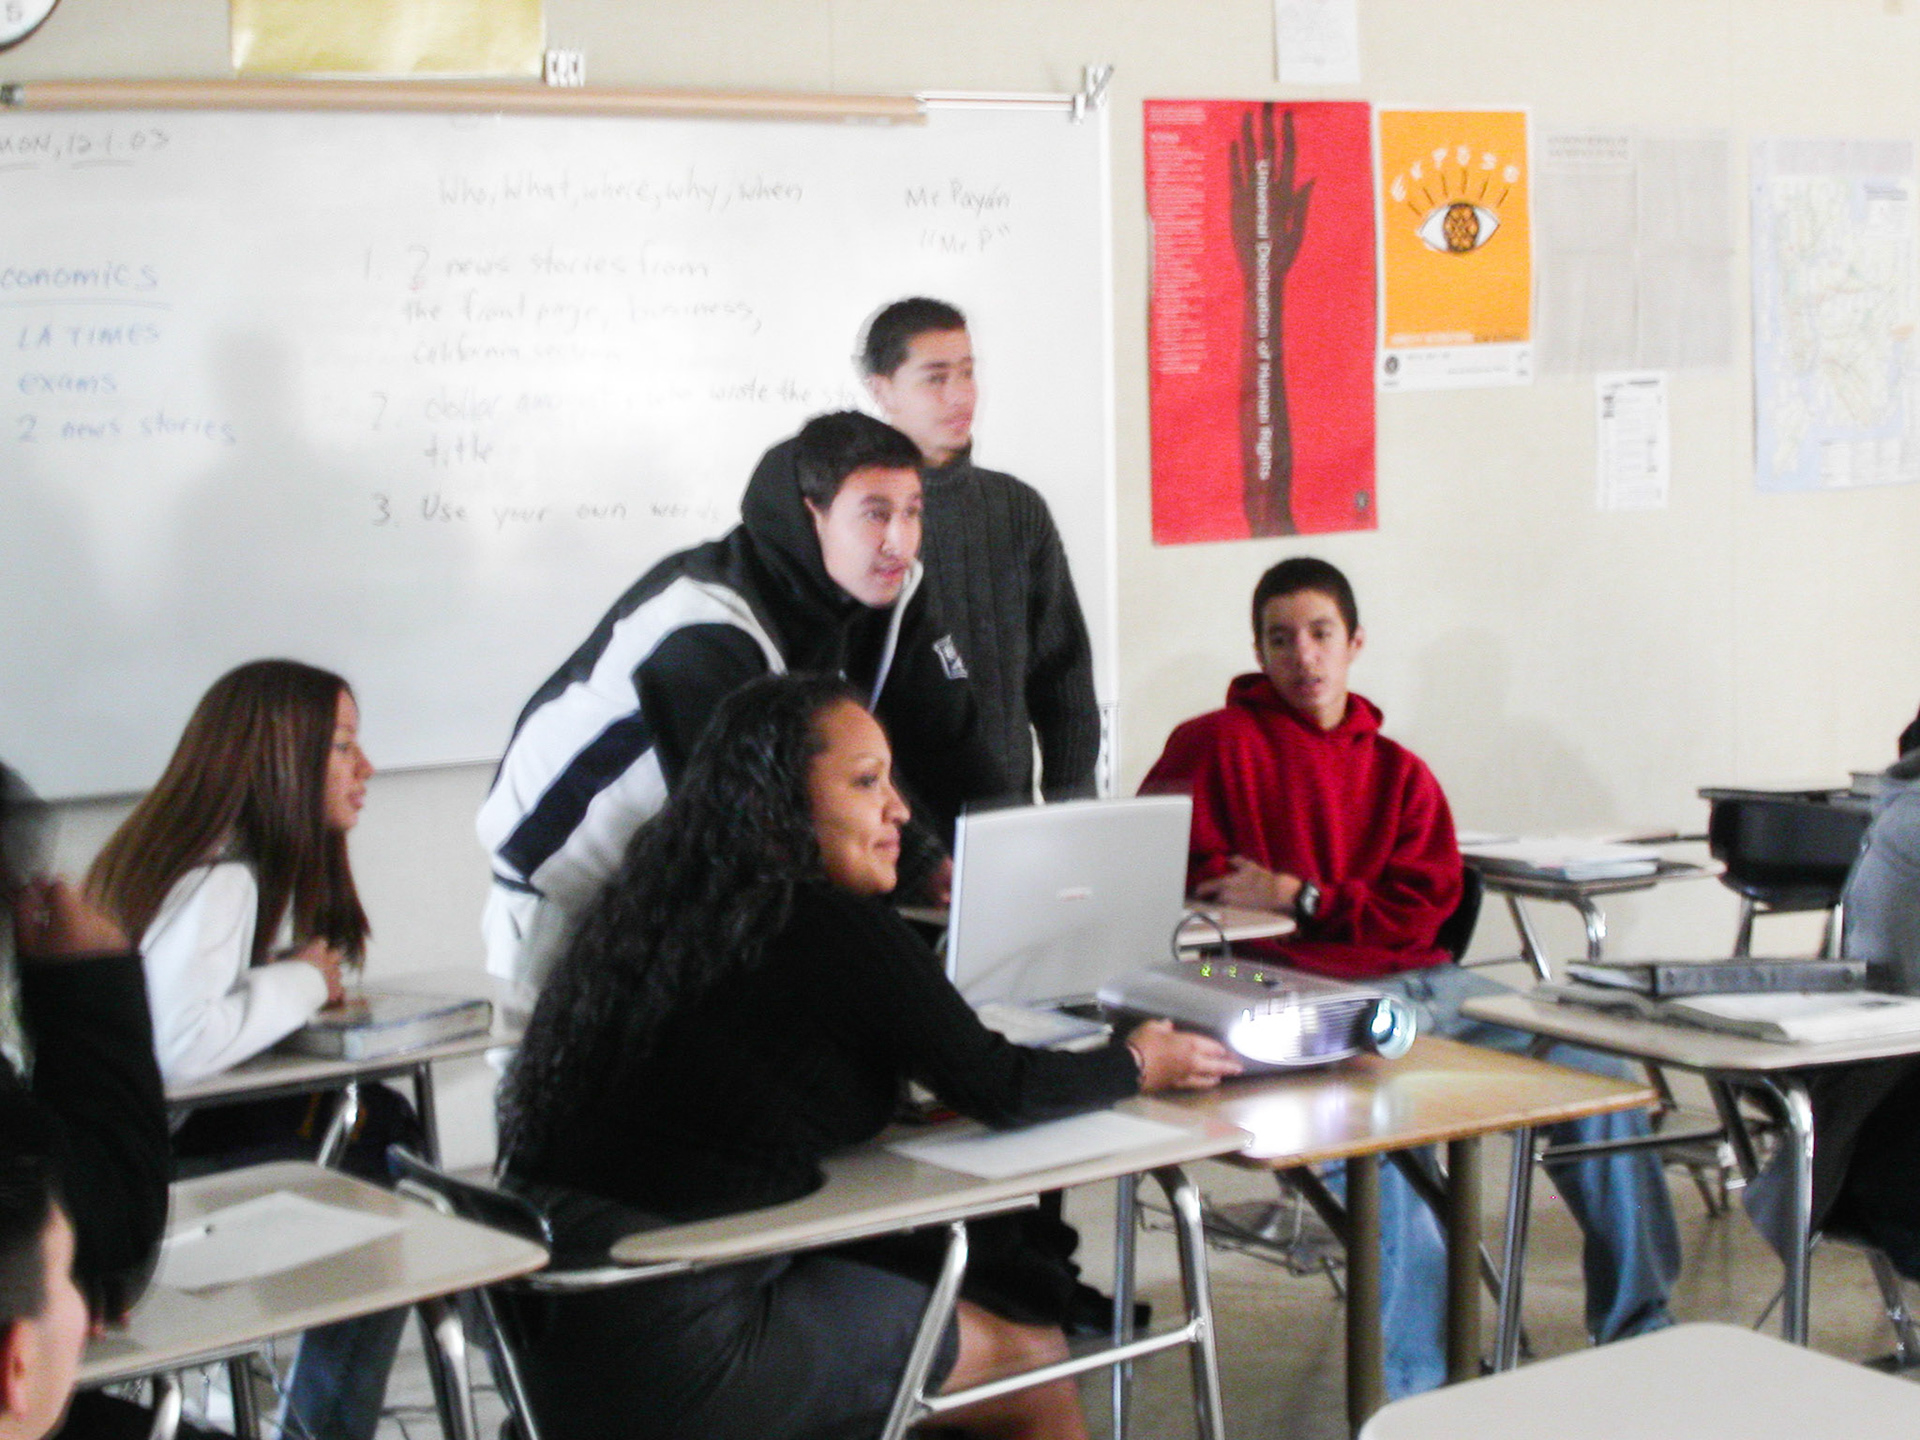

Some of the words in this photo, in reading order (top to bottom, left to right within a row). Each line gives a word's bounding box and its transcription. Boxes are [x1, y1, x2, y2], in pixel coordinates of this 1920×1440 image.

[1255, 159, 1270, 239] Universal
[445, 255, 511, 278] news
[530, 243, 627, 276] stories
[639, 237, 710, 279] from
[1255, 240, 1272, 339] Declaration
[403, 297, 441, 325] the
[17, 324, 52, 350] LA
[66, 322, 160, 349] TIMES
[1256, 340, 1271, 360] of
[17, 372, 118, 396] exams
[709, 375, 768, 403] wrote
[1256, 362, 1271, 424] Human
[16, 413, 38, 443] 2
[60, 416, 121, 440] news
[140, 406, 238, 446] stories
[422, 432, 494, 468] title
[1255, 425, 1273, 481] Rights
[420, 492, 467, 523] Use
[493, 503, 551, 535] your
[575, 502, 627, 521] own
